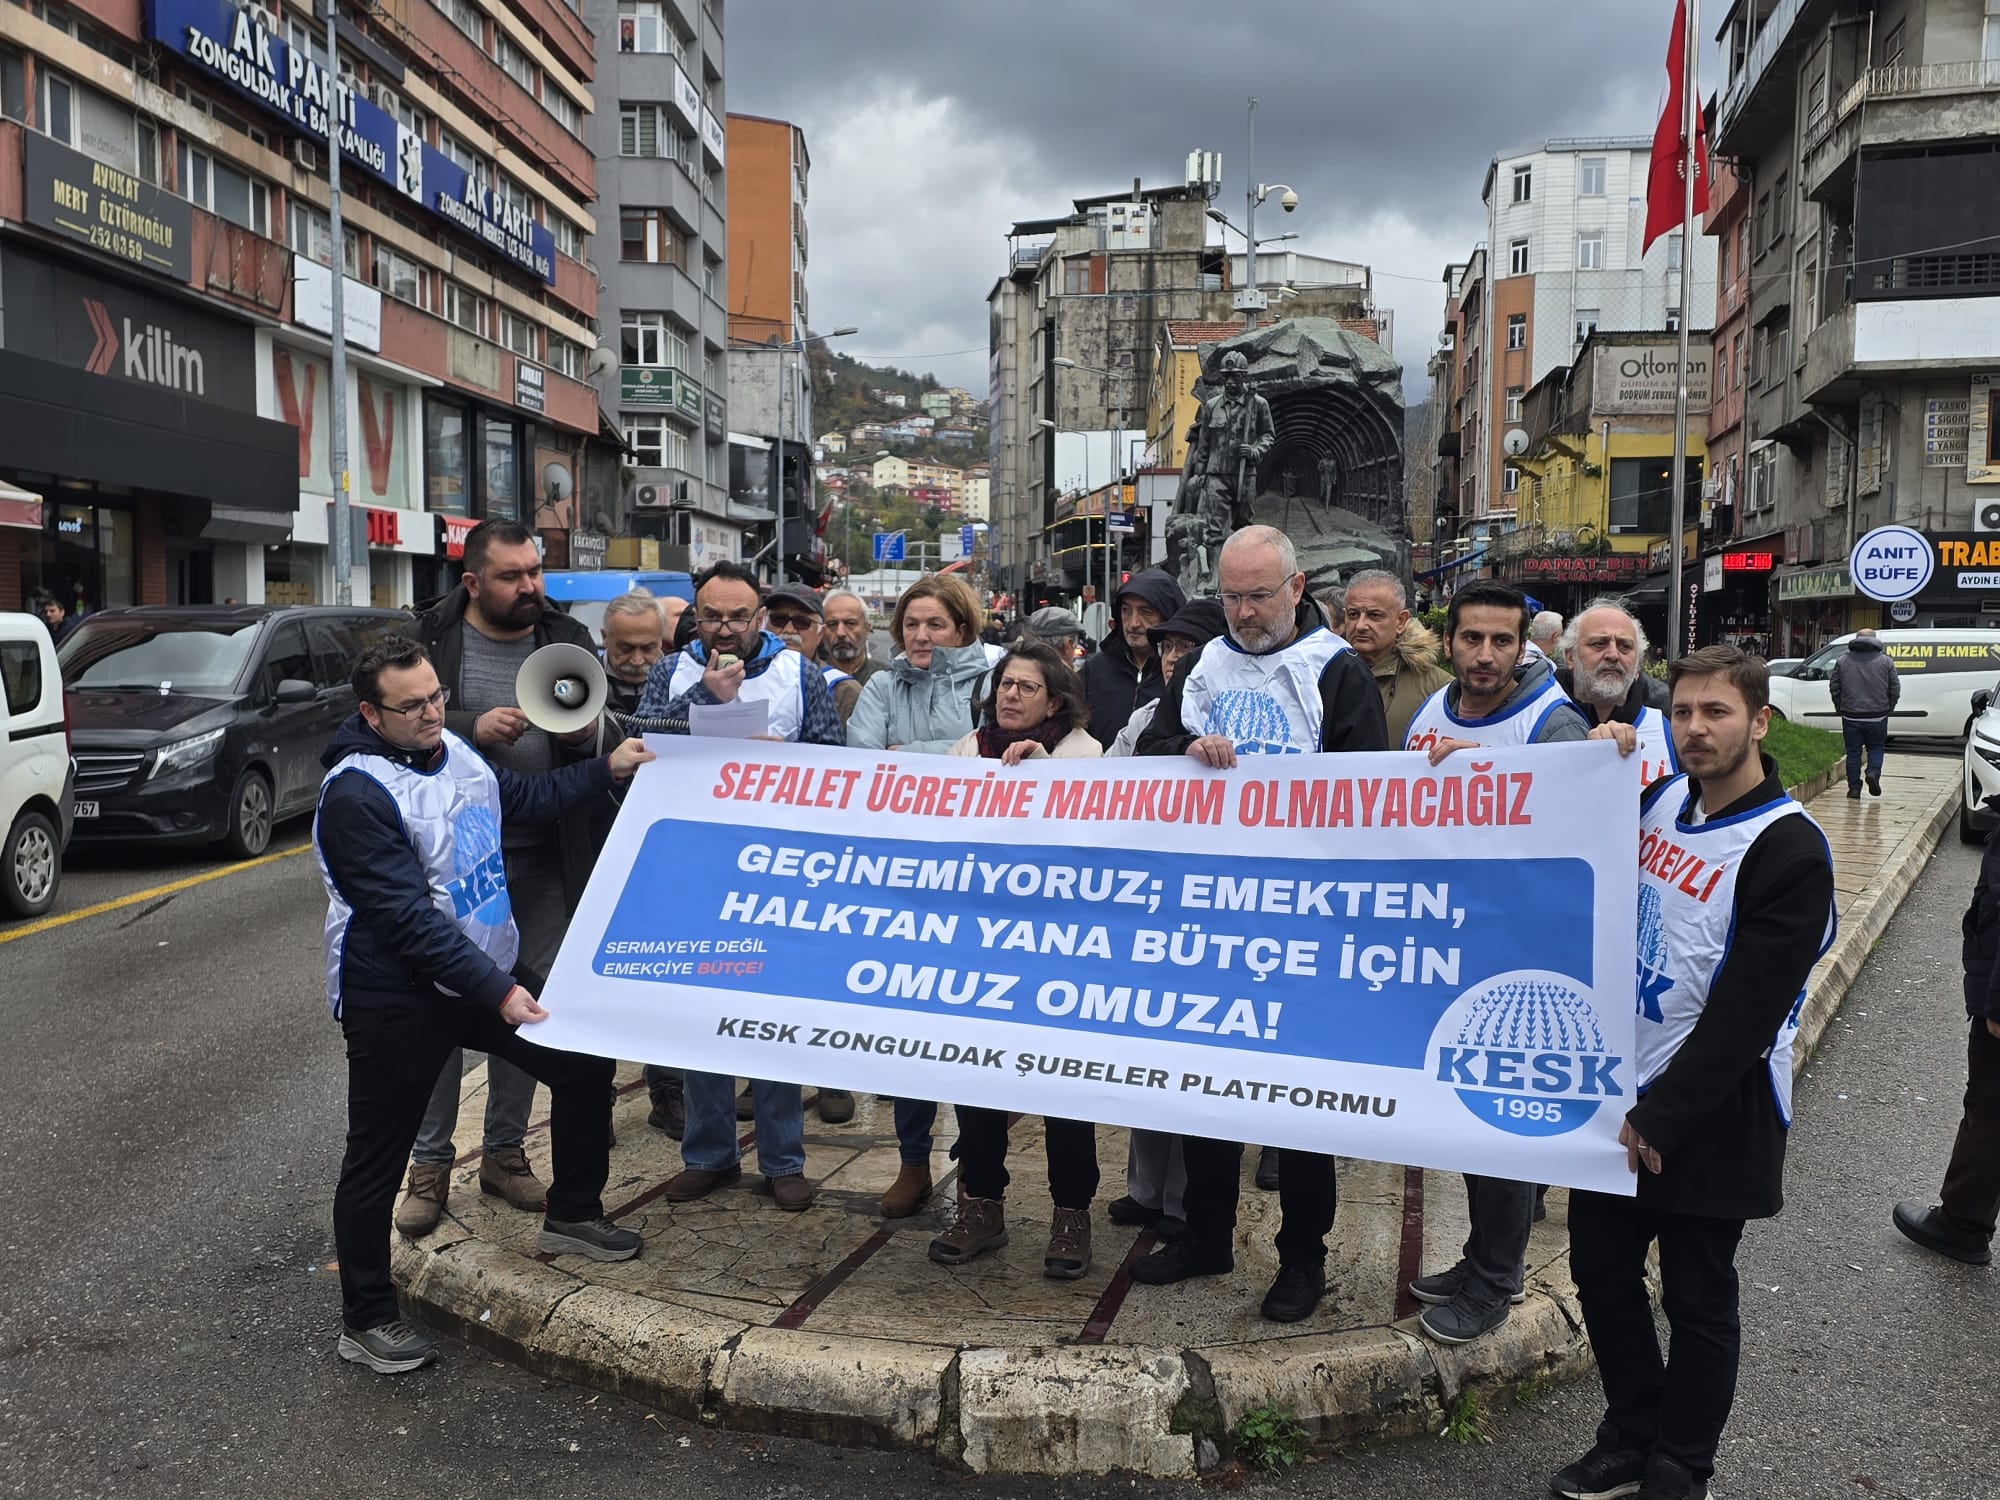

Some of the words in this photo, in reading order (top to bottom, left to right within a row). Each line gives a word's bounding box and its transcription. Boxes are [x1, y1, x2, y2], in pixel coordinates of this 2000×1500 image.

[233, 10, 276, 76] AK
[189, 26, 291, 113] ZONGULDAK
[294, 94, 307, 124] İL
[310, 107, 386, 173] BAKANLIĞI
[92, 162, 140, 203] AVUKAT
[53, 178, 89, 214] MERT
[99, 193, 173, 249] ÖZTÜRKOĞLU
[439, 191, 481, 235] ZONGULDAK
[465, 174, 489, 218] AK
[493, 192, 533, 247] PARTİ
[123, 317, 205, 395] kilim
[1619, 389, 1651, 401] BODRUM
[1651, 390, 1677, 401] SEBZEL
[1672, 380, 1707, 388] KBAP
[1938, 401, 1967, 410] KASKO
[1937, 414, 1969, 424] SİGORT
[1937, 428, 1969, 438] DEPRE
[1937, 441, 1968, 450] YANGI
[367, 508, 403, 546] STEL
[448, 524, 471, 545] KAR
[1524, 557, 1599, 571] DAMAT
[1606, 557, 1649, 570] BEY
[1867, 547, 1919, 560] ANIT
[1938, 541, 2000, 566] TRAB
[1864, 564, 1919, 580] BÜFE
[1960, 576, 1991, 585] AYDIN
[1892, 608, 1913, 617] BÜFE
[1886, 643, 1933, 658] NİZAM
[1936, 645, 1989, 658] EKMEK
[712, 761, 862, 810] SEFALET
[866, 763, 1038, 818] ÜCRETİNE
[1042, 778, 1227, 826] MAHKUM
[1238, 761, 1533, 828] OLMAYACAĞIZ
[1639, 826, 1728, 904] ÖREVLİ
[736, 842, 1163, 914] GEÇİNEMİYORUZ;
[1180, 874, 1466, 929] EMEKTEN,
[604, 940, 711, 954] SERMAYEYE
[715, 936, 768, 954] DEĞİL
[719, 890, 959, 944] HALKTAN
[976, 915, 1112, 960] YANA
[1131, 923, 1320, 982] BÜTÇE
[1339, 934, 1461, 992] İÇİN
[602, 959, 695, 979] EMEKÇİYE
[697, 959, 765, 977] BÜTÇE!
[845, 959, 1021, 1011] OMUZ
[1036, 980, 1283, 1041] OMUZA!
[716, 1016, 803, 1044] KESK
[807, 1027, 1007, 1070] ZONGULDAK
[1014, 1052, 1170, 1092] ŞUBELER
[1180, 1073, 1398, 1118] PLATFORMU
[1436, 1046, 1624, 1097] KESK
[1492, 1097, 1562, 1123] 1995
